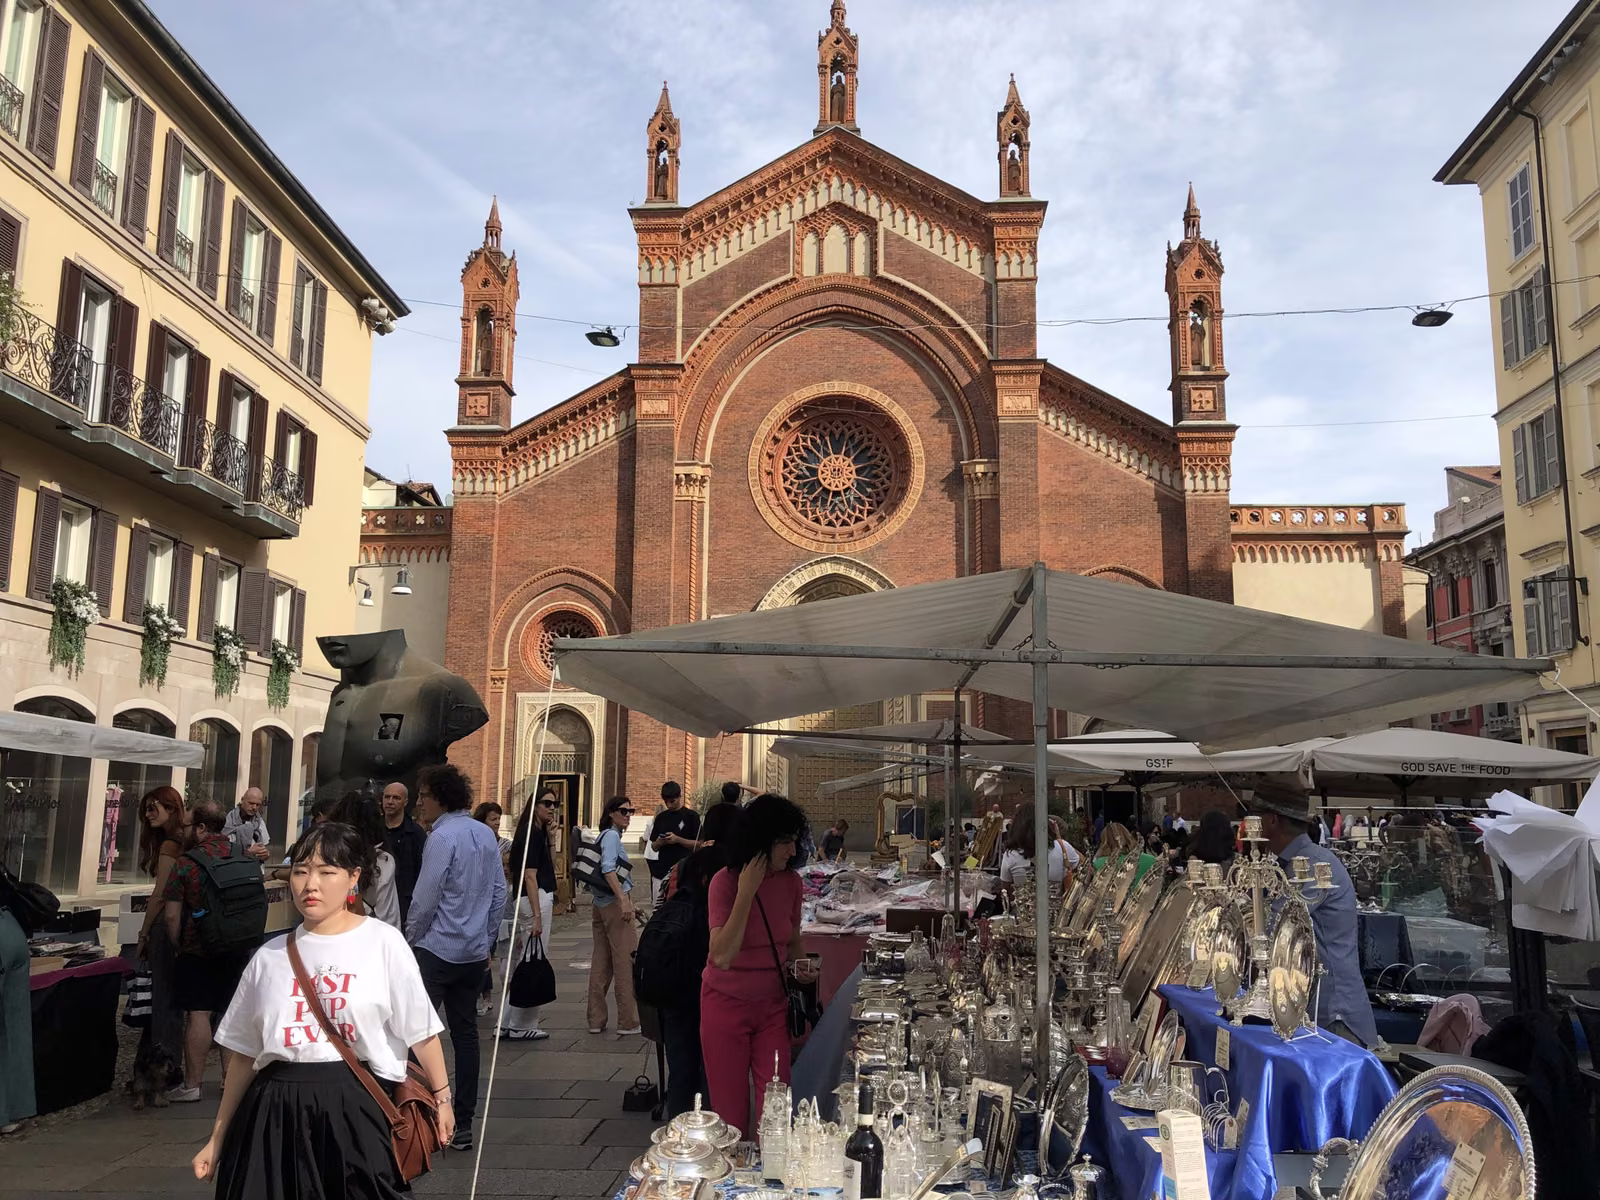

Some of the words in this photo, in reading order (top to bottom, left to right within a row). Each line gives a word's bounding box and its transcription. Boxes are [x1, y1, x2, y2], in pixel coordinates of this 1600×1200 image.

[1401, 762, 1425, 772] GOD
[1428, 763, 1457, 773] SAVE
[1479, 765, 1511, 775] FOOD
[289, 973, 357, 997] ST
[293, 997, 347, 1022] PP
[282, 1022, 357, 1048] EVR
